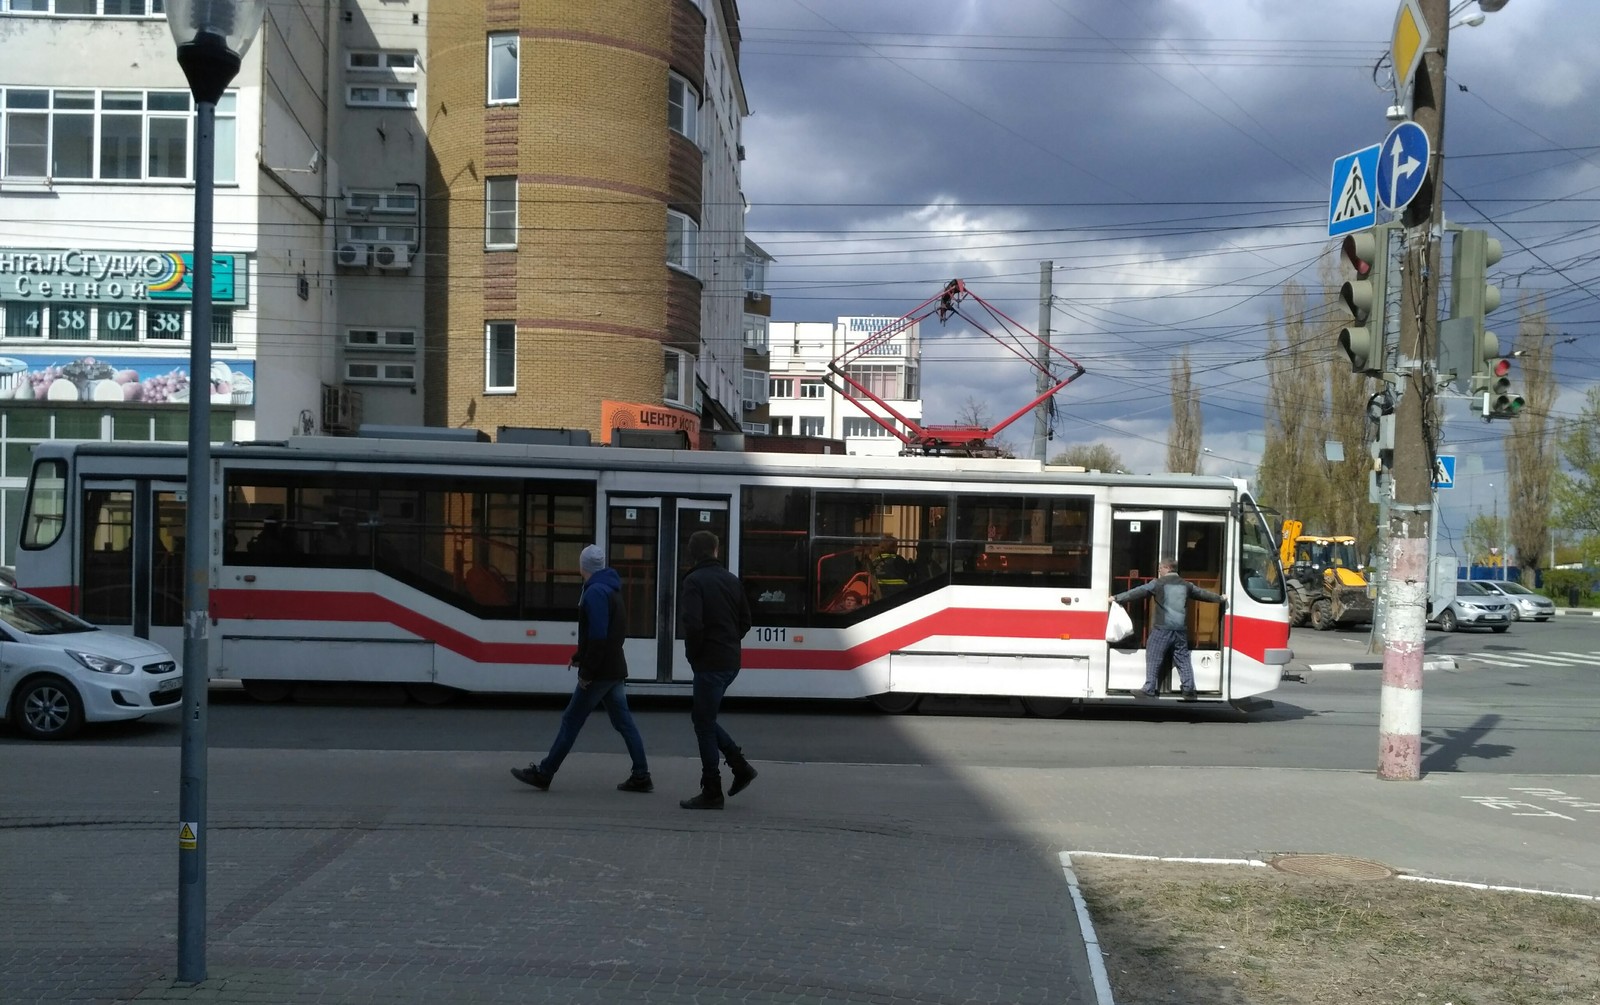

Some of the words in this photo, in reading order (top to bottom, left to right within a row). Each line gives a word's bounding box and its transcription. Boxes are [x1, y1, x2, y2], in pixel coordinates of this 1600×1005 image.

[15, 275, 148, 299] Сенной
[25, 311, 40, 329] 4
[57, 310, 86, 330] 38
[107, 311, 134, 331] 02
[152, 312, 181, 333] 38
[640, 410, 677, 428] ЦЕНТР
[756, 627, 786, 642] 1011
